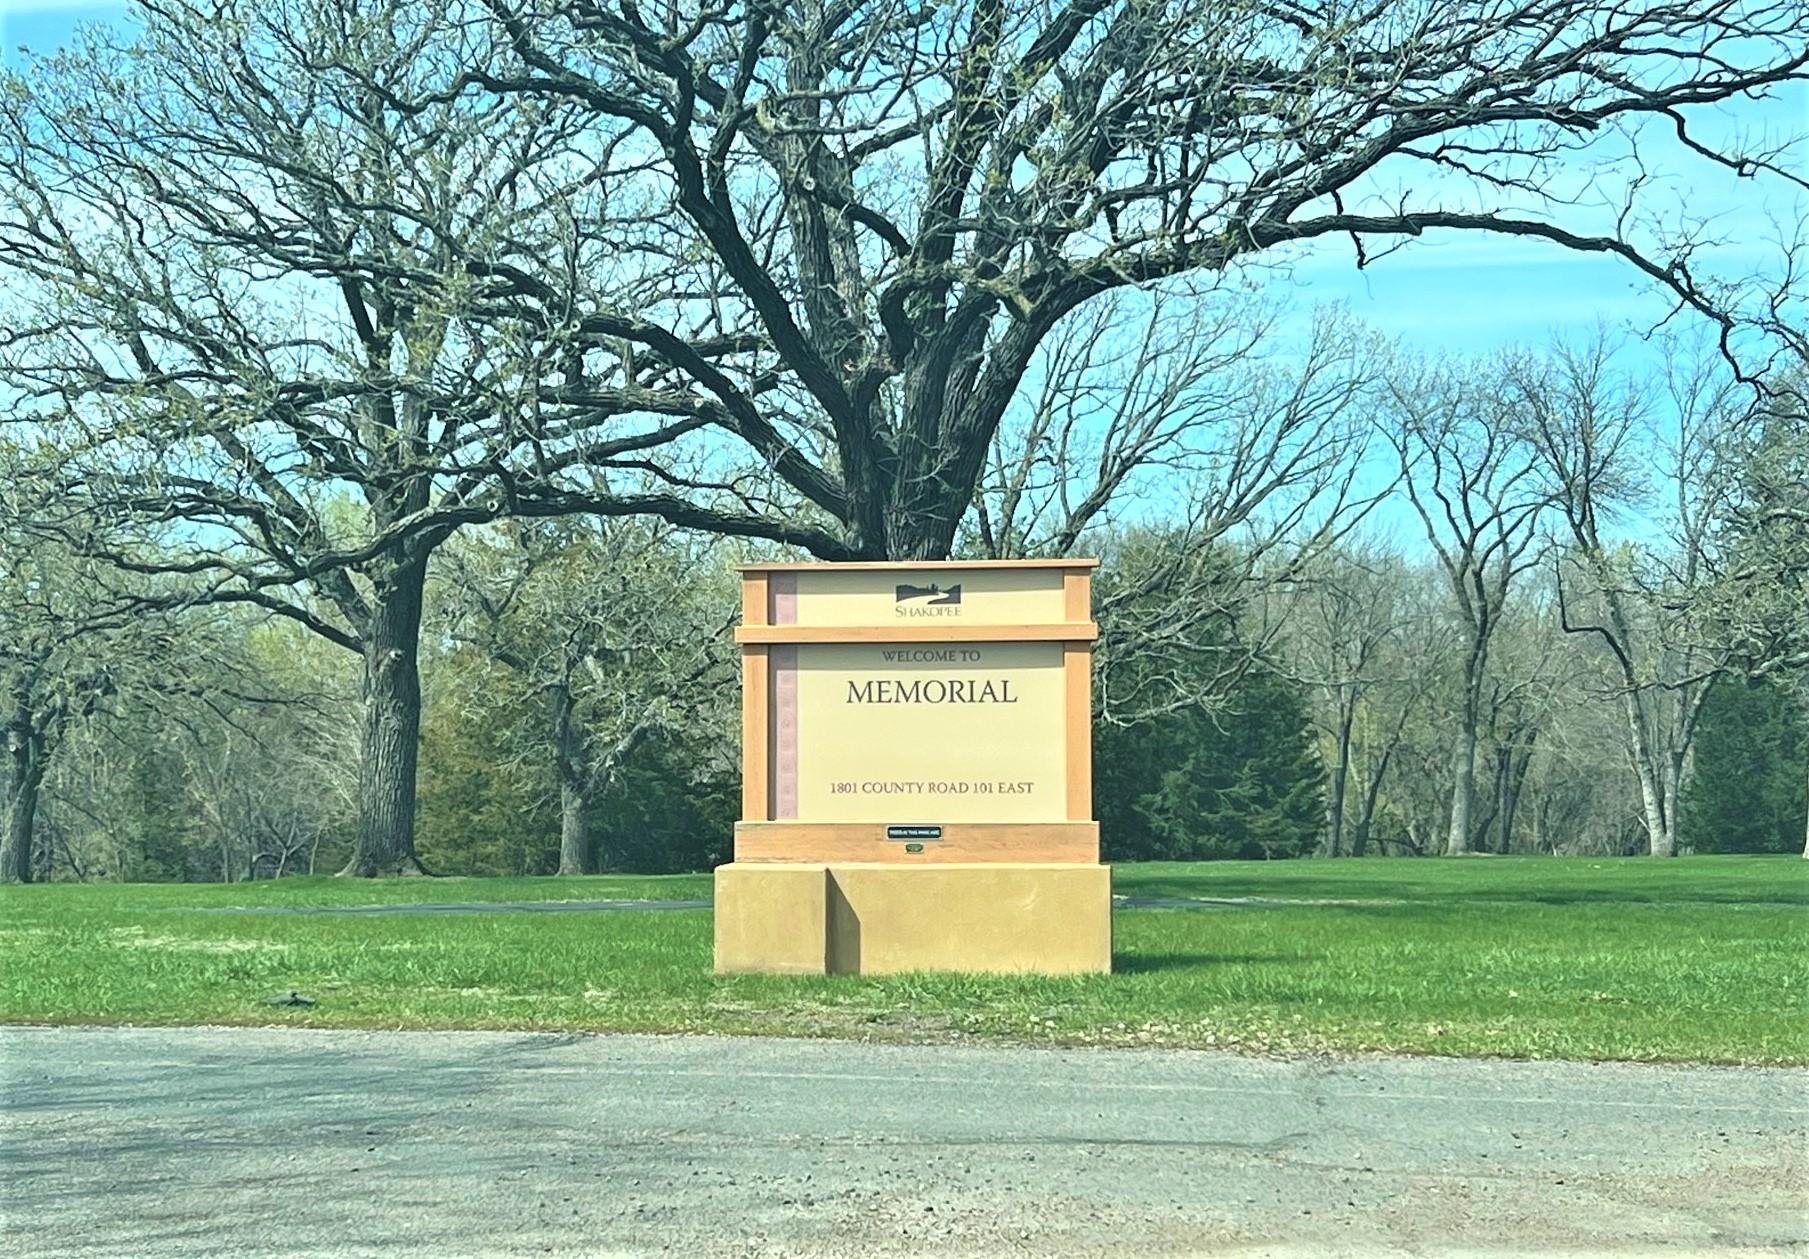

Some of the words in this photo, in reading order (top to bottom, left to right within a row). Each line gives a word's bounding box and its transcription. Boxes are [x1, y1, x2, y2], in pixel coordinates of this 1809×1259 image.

[895, 606, 962, 618] SHAKOPEE
[882, 650, 956, 662] WELCOME
[960, 650, 981, 662] TO
[846, 680, 1018, 704] MEMORIAL
[831, 782, 858, 794] 1801
[862, 782, 924, 794] COUNTY
[928, 782, 970, 794] ROAD
[973, 782, 993, 794] 101
[998, 782, 1035, 794] EAST
